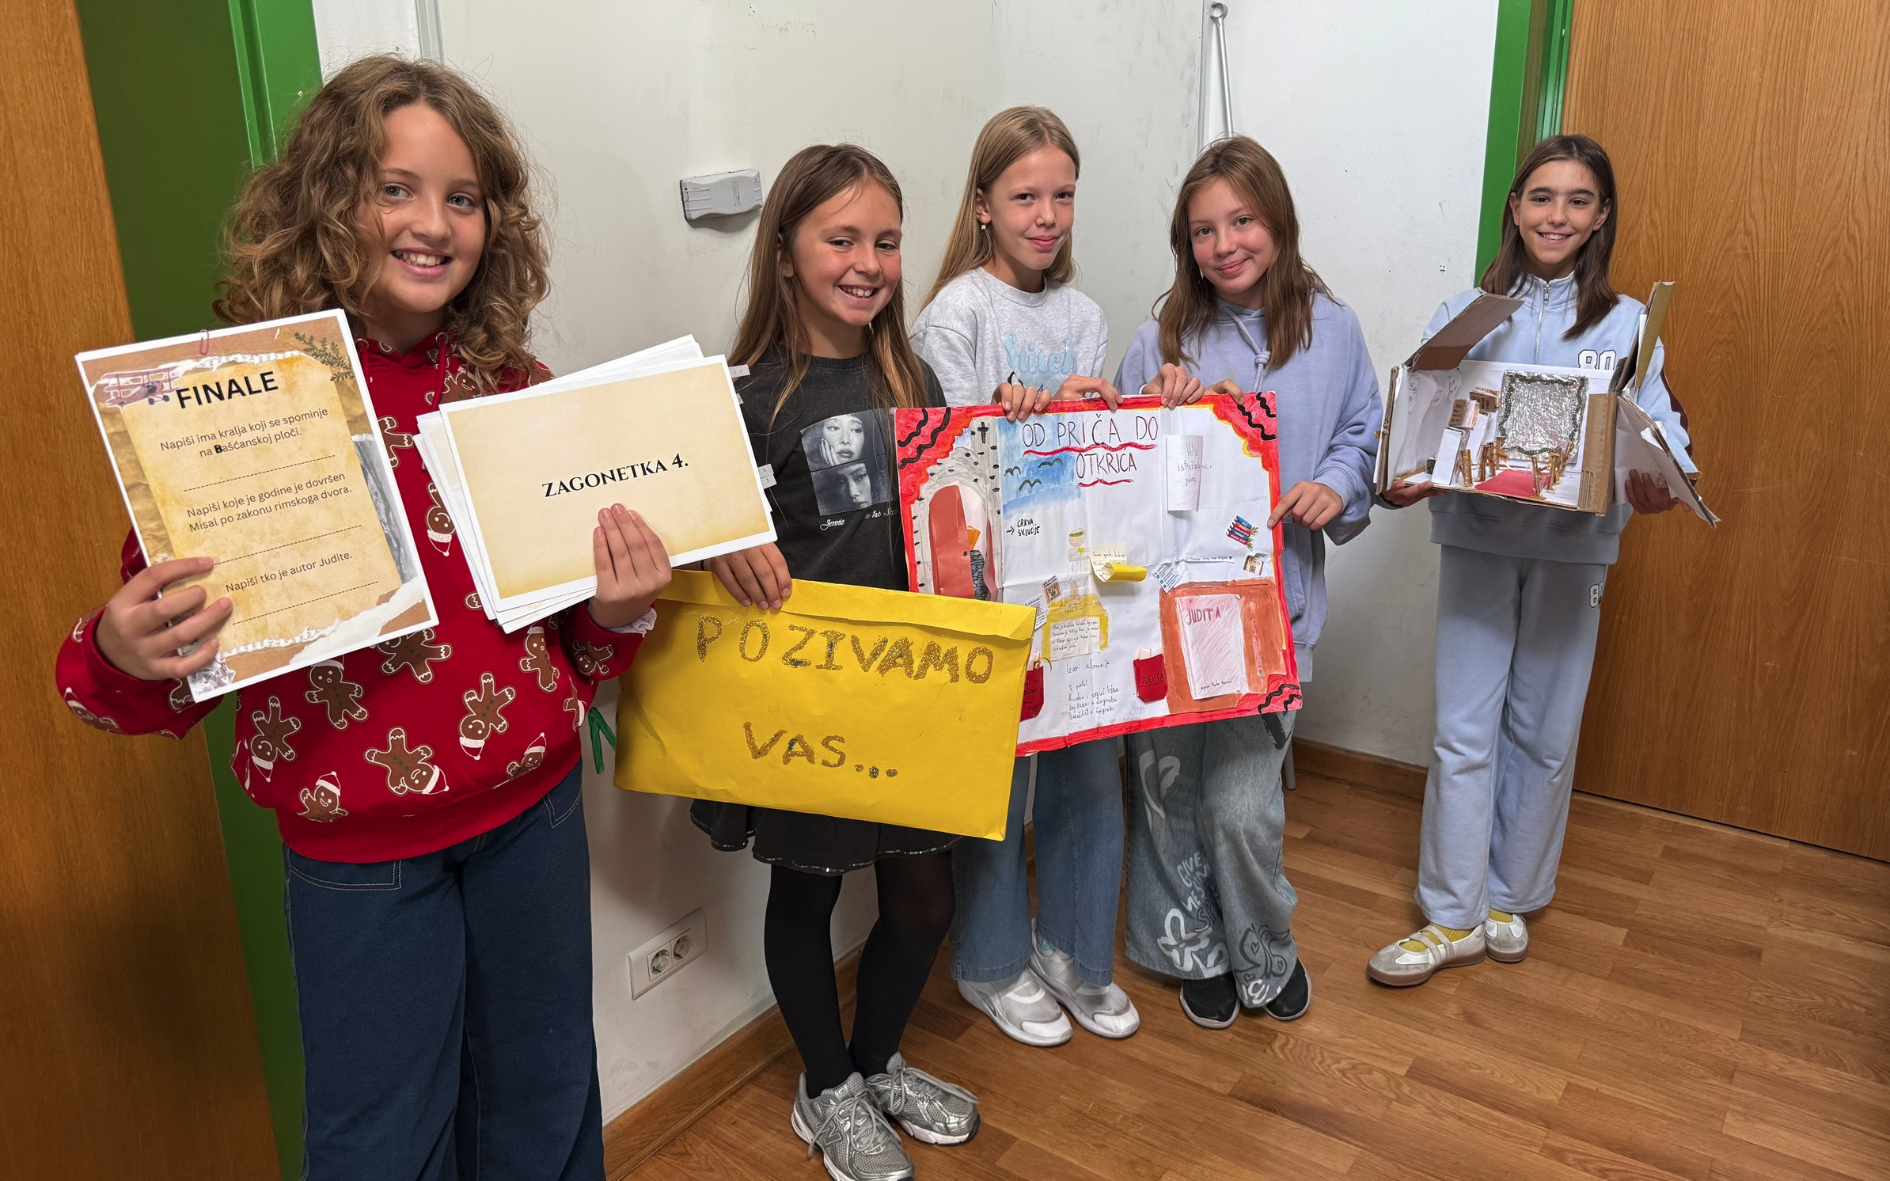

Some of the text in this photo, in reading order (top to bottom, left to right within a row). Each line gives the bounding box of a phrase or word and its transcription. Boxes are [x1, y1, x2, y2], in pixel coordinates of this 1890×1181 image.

[176, 371, 279, 409] FINALE
[160, 408, 329, 451] Napiši ima kralja koji se spominje
[200, 427, 302, 458] na Bašćanskoj ploči.
[1022, 413, 1158, 447] OD PRIČA DO
[187, 472, 346, 518] Napiši koje je godine je dovršen
[541, 453, 689, 498] ZAGONETKA 4.
[189, 486, 352, 533] Misal po zakonu rimskoga dvora.
[225, 550, 353, 593] Napiši tko je autor Judite.
[1186, 606, 1222, 626] JUDITA
[696, 614, 995, 685] POZIVAMO
[1140, 673, 1165, 685] JUDITA
[743, 721, 899, 780] VAS...
[1177, 851, 1203, 888] GIVE
